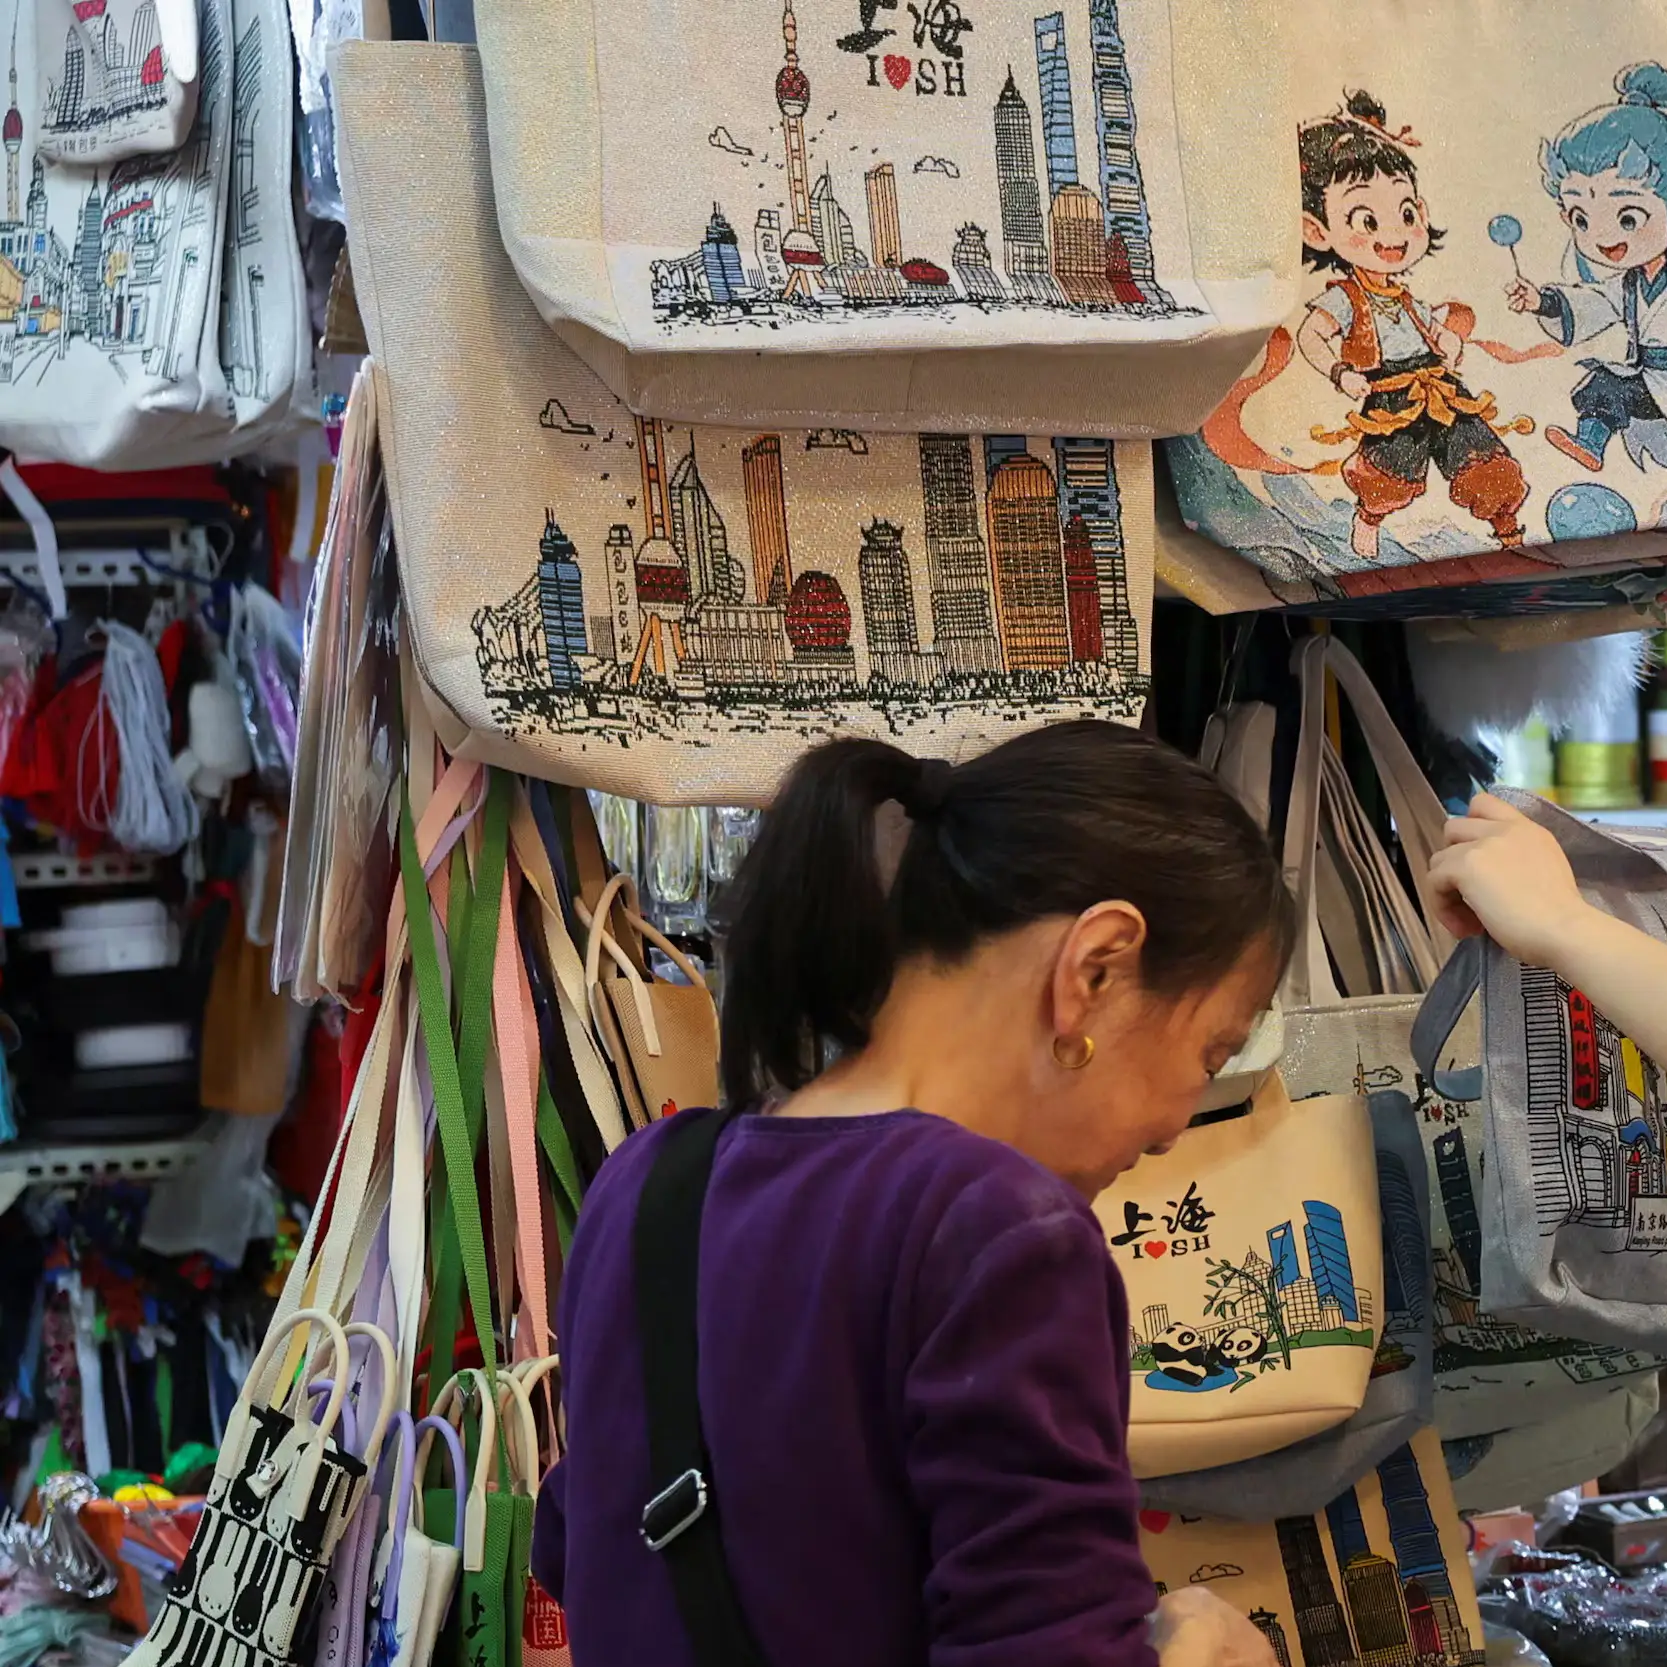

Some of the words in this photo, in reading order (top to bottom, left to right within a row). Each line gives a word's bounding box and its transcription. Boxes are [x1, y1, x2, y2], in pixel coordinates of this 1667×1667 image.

[866, 54, 880, 87] I
[915, 58, 967, 97] SH
[1110, 1181, 1216, 1247] 上海
[1171, 1234, 1211, 1258] SH
